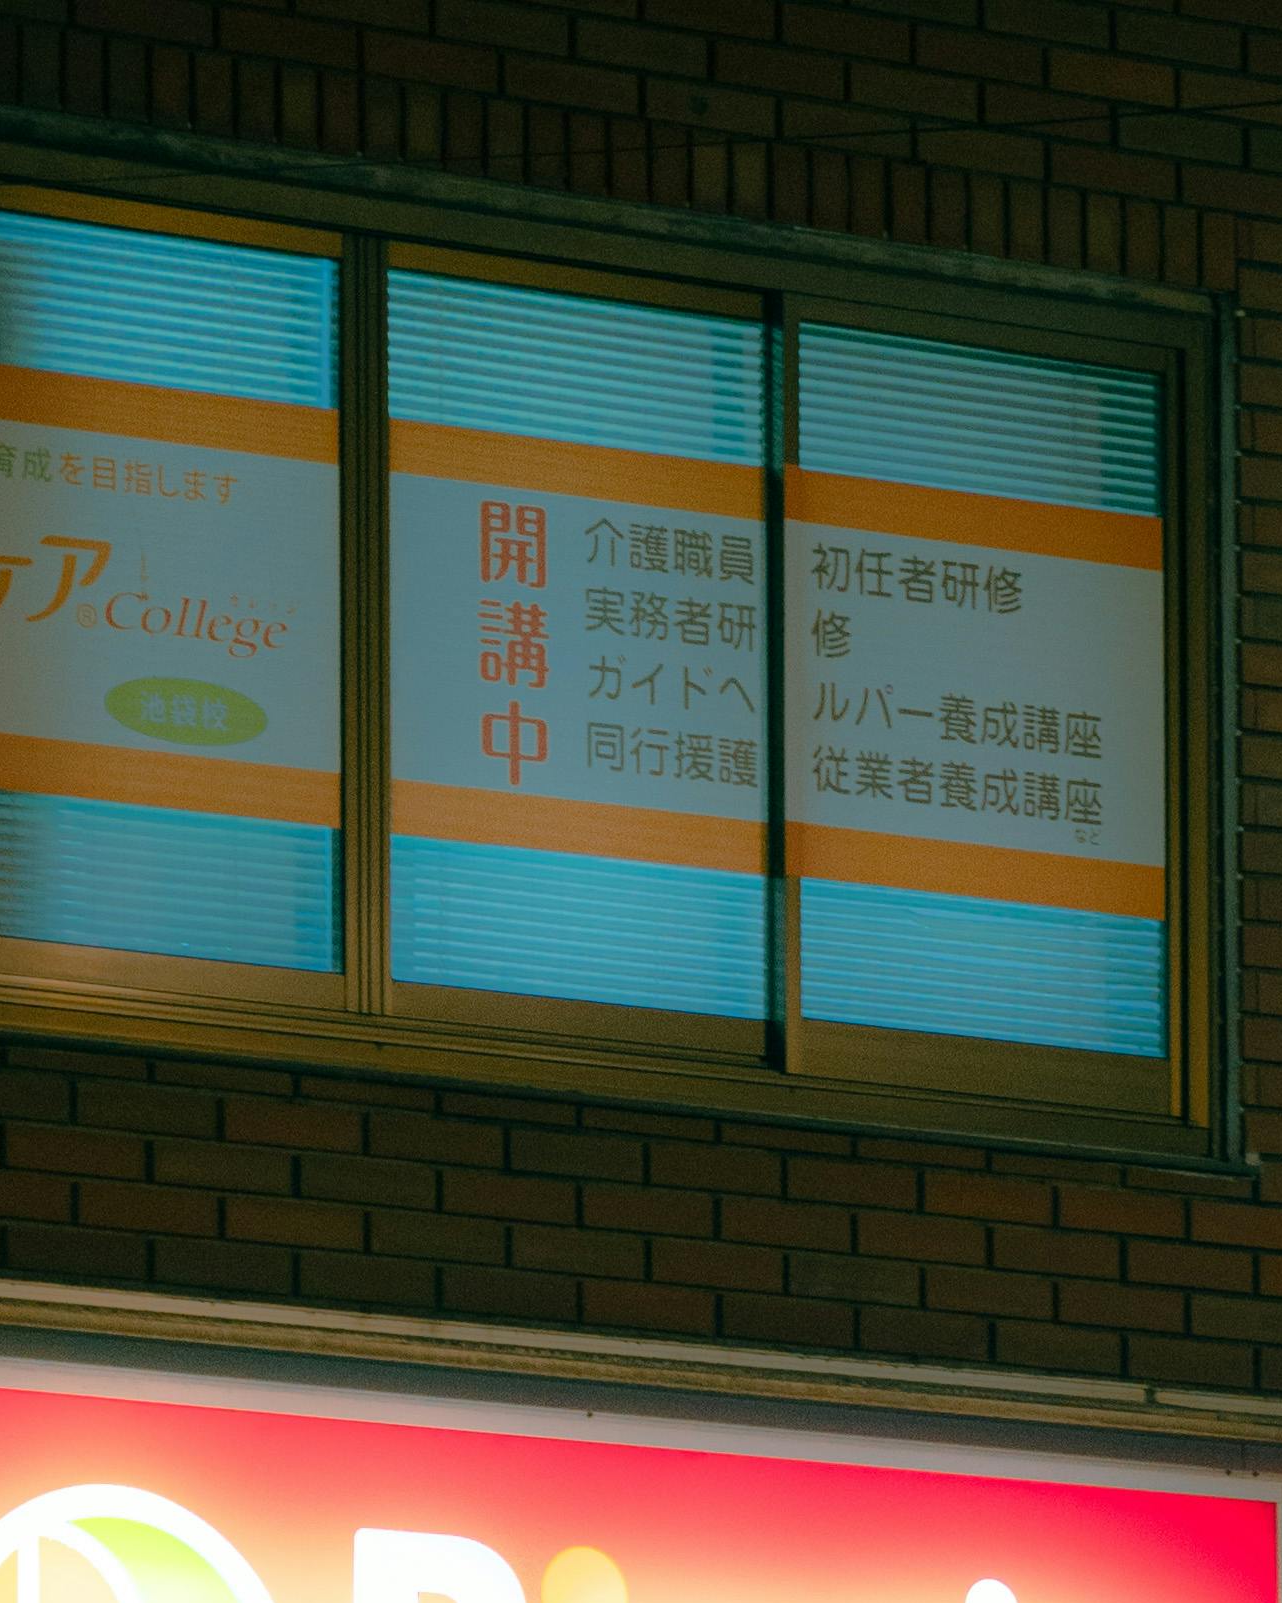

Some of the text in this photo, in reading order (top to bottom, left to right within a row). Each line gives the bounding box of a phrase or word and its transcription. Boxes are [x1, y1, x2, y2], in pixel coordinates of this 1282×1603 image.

[584, 516, 1025, 616] 介護職員 初任者研修
[104, 590, 289, 659] College
[478, 499, 551, 787] 開講中
[584, 586, 853, 661] 実務者研 修
[811, 682, 1105, 761] ルパー養成講座
[584, 722, 1105, 827] 同行援護 従業者養成講座
